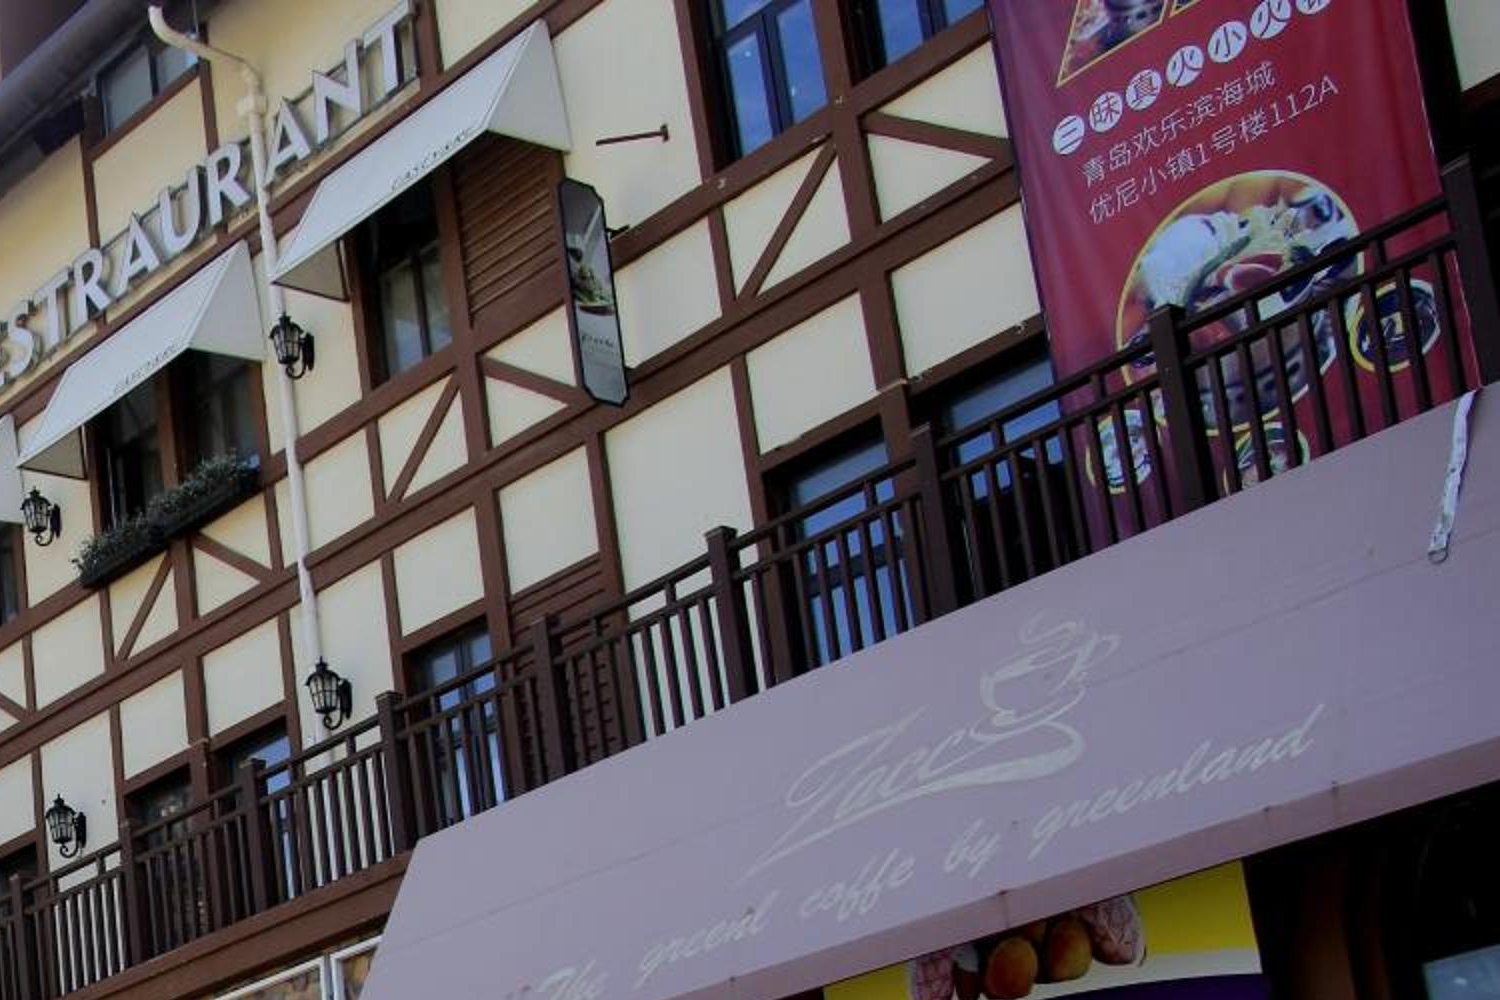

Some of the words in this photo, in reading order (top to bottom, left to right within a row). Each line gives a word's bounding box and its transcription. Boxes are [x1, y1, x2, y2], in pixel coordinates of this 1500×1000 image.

[1080, 61, 1276, 187] 青岛欢乐滨海城
[1089, 75, 1339, 225] 优尼小镇1号楼112A
[946, 818, 1000, 877] by
[1027, 704, 1325, 861] greenland
